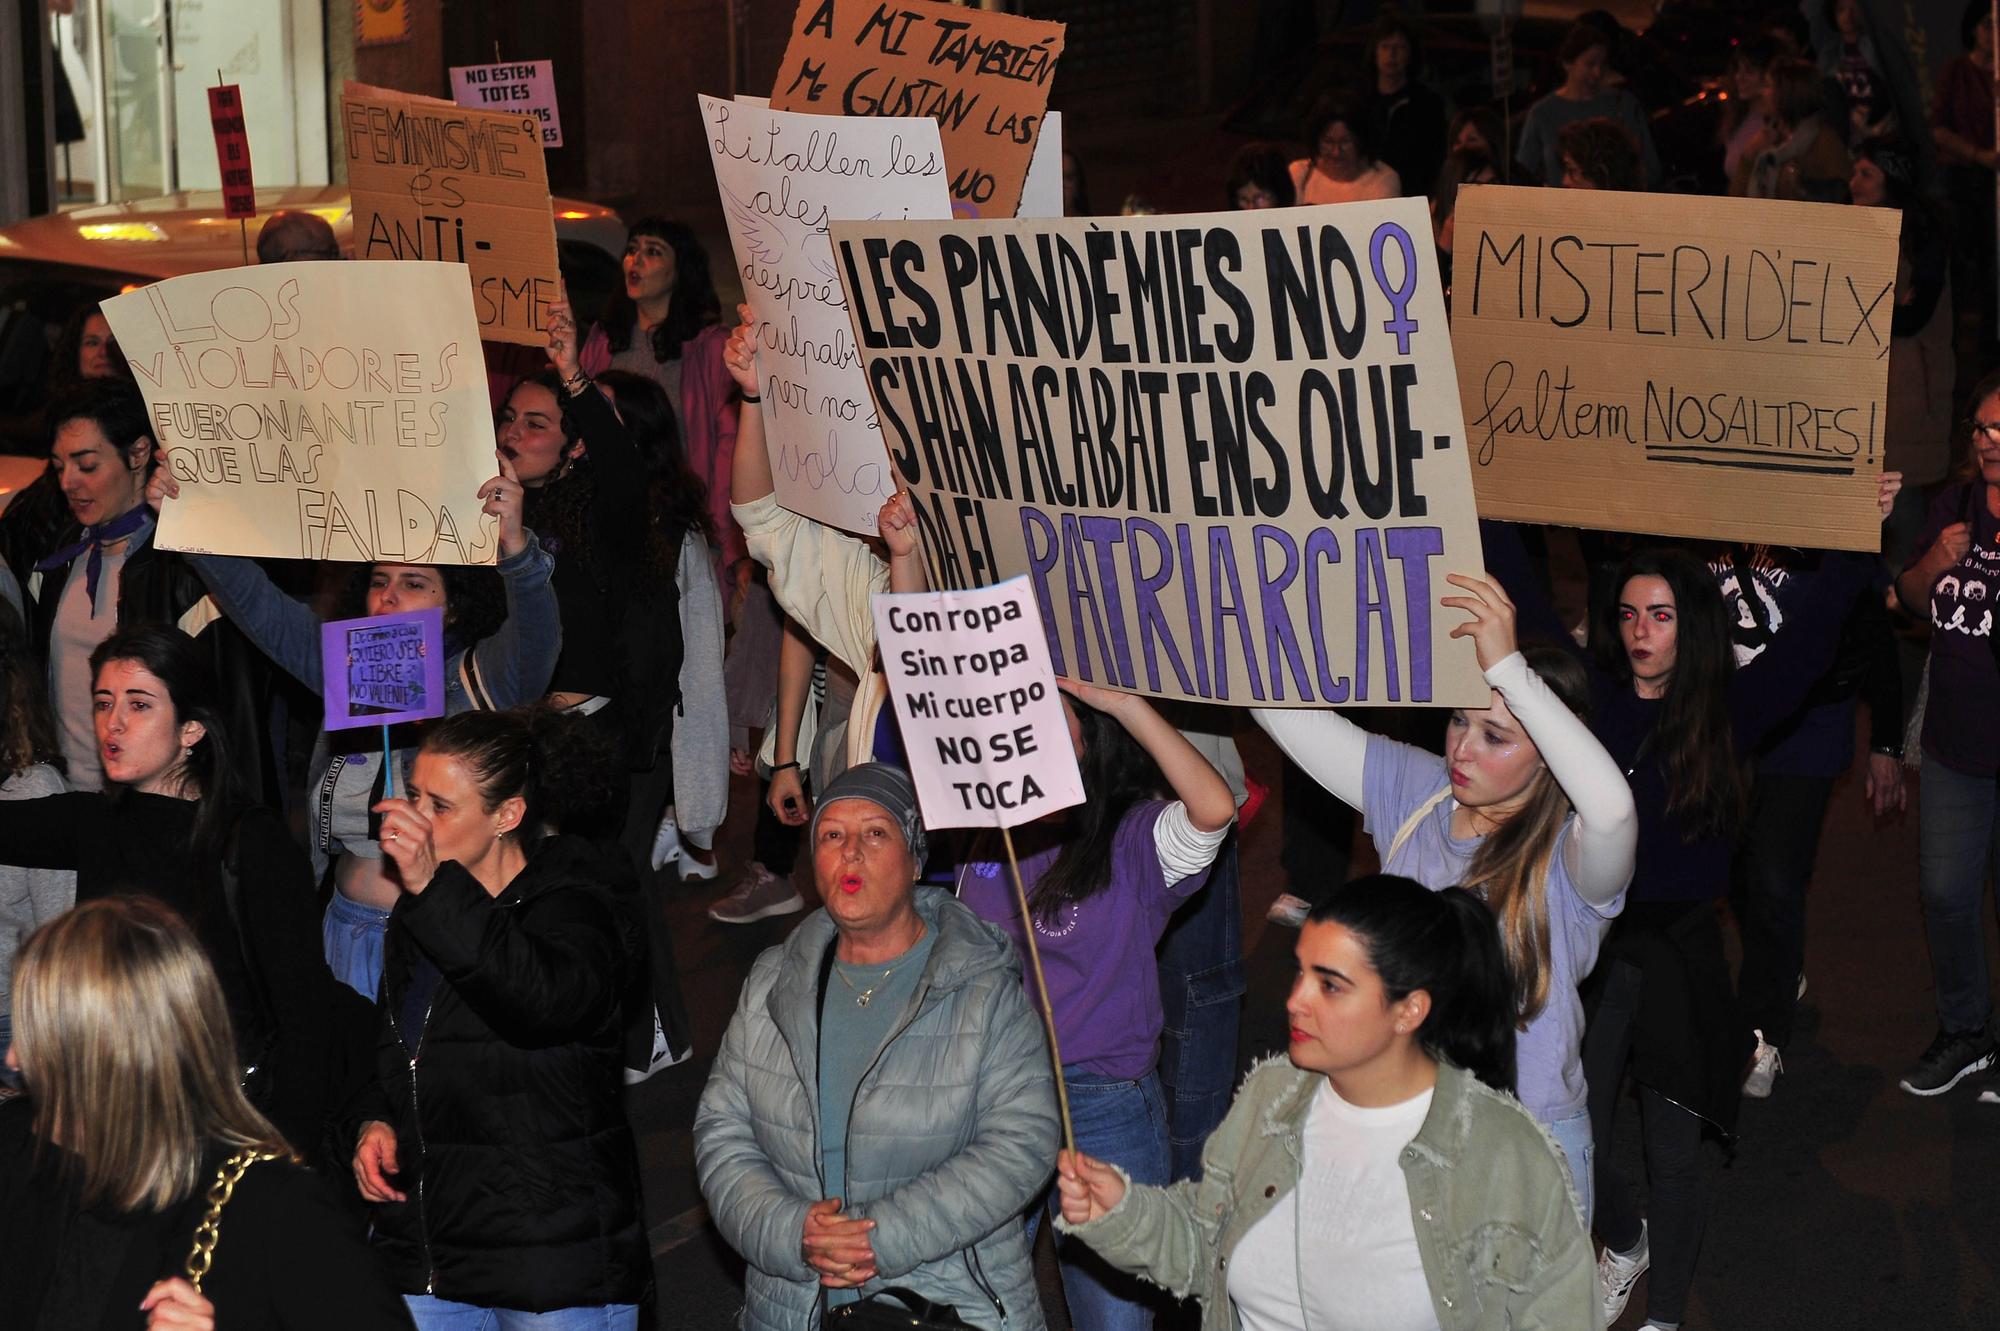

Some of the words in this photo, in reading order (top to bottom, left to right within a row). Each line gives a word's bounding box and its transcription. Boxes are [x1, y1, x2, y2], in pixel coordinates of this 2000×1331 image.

[803, 0, 834, 38] A
[855, 3, 925, 56] MI
[928, 19, 1057, 87] TAMBIÉN
[466, 69, 488, 84] NO
[491, 65, 536, 81] ESTEM
[479, 84, 530, 102] TOTES
[843, 68, 980, 131] GUSTAN
[985, 105, 1037, 144] LAS
[346, 103, 526, 178] FEMINISME
[764, 119, 874, 177] tallen
[881, 135, 943, 178] les
[407, 168, 465, 208] és
[746, 176, 830, 233] ales
[742, 253, 848, 311] despré
[839, 237, 942, 350] LES
[938, 221, 1255, 365] PANDÈMIES
[1261, 224, 1367, 362] NO
[1472, 229, 1731, 341] MISTERI
[1745, 247, 1894, 361] D'ELX,
[146, 278, 300, 345] LOS
[767, 374, 812, 419] per
[820, 396, 861, 421] no
[1472, 360, 1638, 467] faltem
[166, 446, 241, 484] QUE
[249, 442, 323, 484] LAS
[869, 355, 1012, 500] S'HAN
[1006, 363, 1172, 515] ACABAT
[1176, 370, 1292, 520] ENS
[298, 488, 498, 566] FALDAS
[888, 606, 943, 634] Con
[947, 599, 1023, 634] ropa
[1019, 504, 1444, 704] PATRIARCAT
[358, 663, 403, 683] LIBRE
[901, 648, 948, 677] Sin
[954, 642, 1030, 677] ropa
[906, 690, 940, 719] Mi
[944, 680, 1046, 719] cuerpo
[935, 736, 983, 765] NO
[989, 723, 1039, 763] SE
[953, 774, 1046, 811] TOCA
